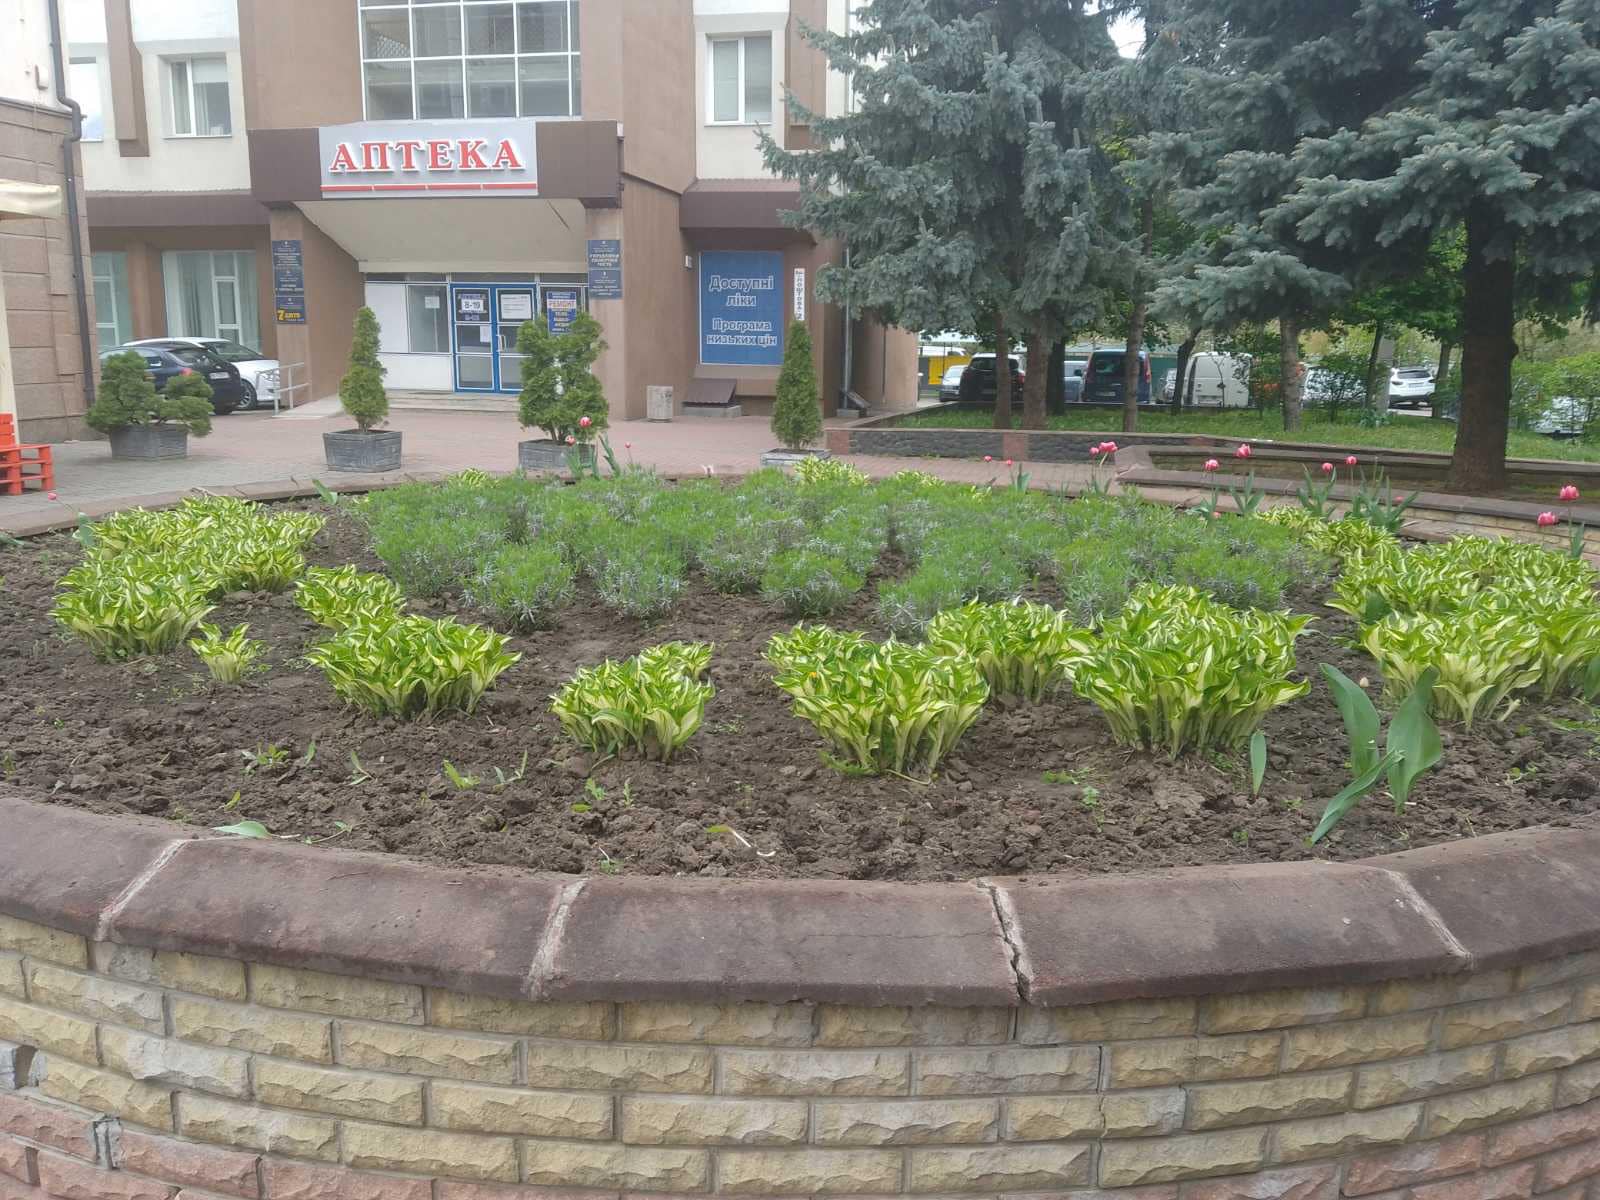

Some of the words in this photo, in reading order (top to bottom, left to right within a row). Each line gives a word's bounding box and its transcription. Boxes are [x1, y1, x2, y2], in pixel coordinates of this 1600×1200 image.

[329, 139, 526, 172] АПТЕКА
[708, 275, 774, 292] Доступні
[726, 292, 757, 307] ліки
[712, 317, 772, 333] Програма
[706, 335, 757, 346] низьких
[757, 333, 778, 348] цін
